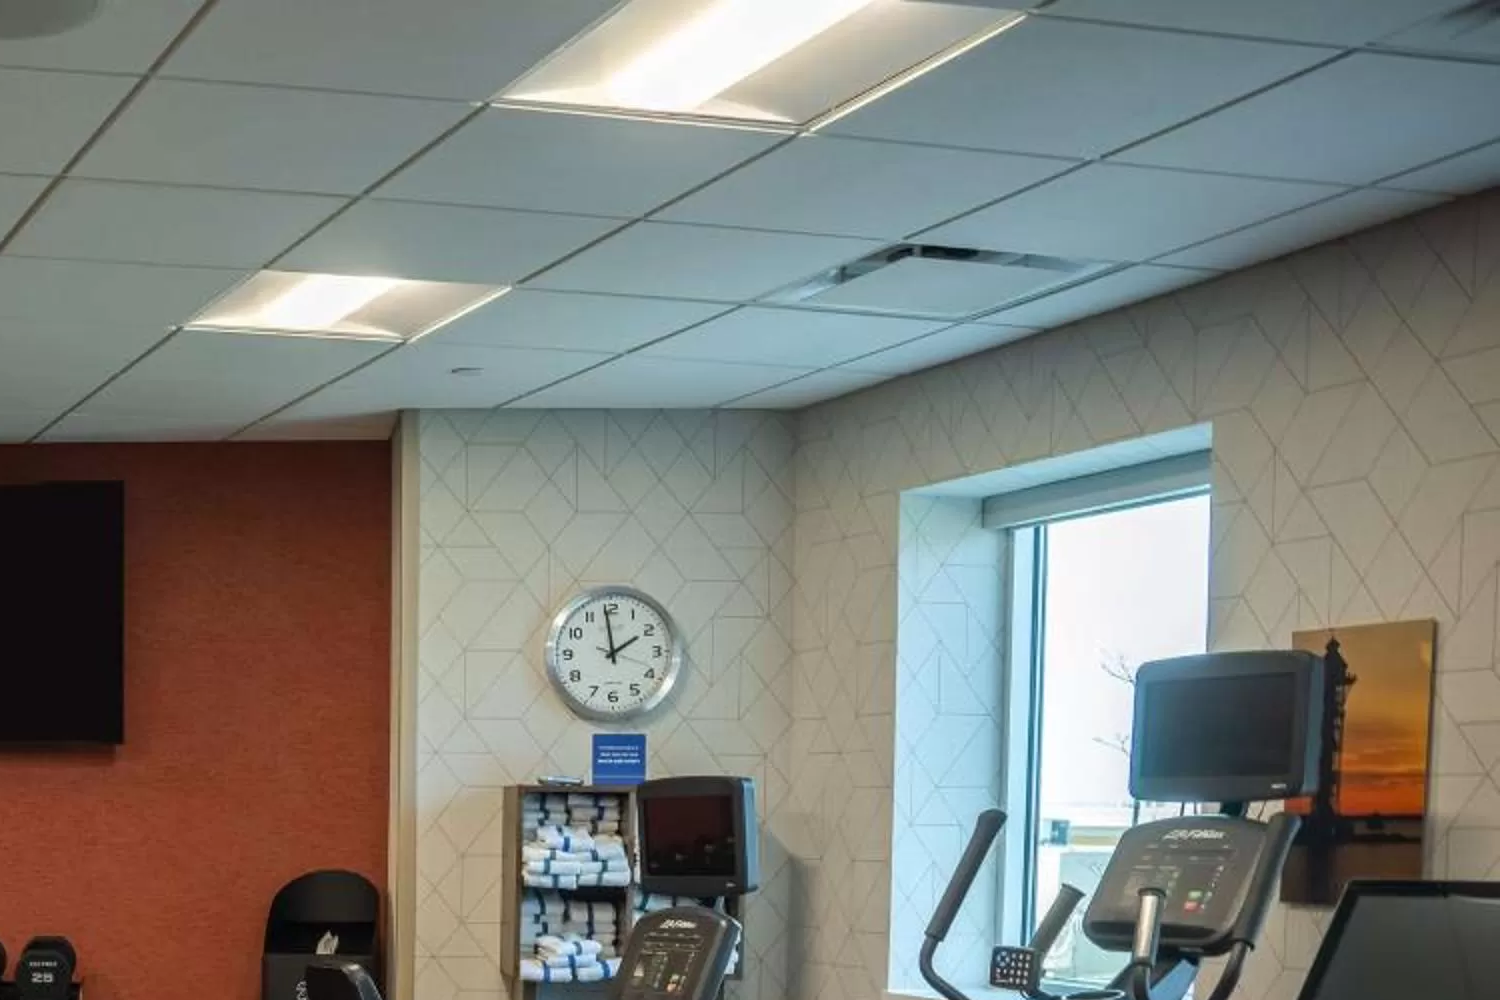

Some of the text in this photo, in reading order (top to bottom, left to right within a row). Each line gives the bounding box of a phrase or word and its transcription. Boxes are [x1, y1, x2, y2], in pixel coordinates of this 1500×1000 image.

[585, 611, 595, 623] 11
[569, 627, 583, 640] 10
[643, 623, 655, 637] 2
[563, 648, 573, 661] 9
[652, 645, 662, 658] 3
[569, 669, 581, 683] 8
[644, 668, 655, 679] 4
[588, 685, 600, 698] 7
[629, 683, 641, 696] 5
[607, 691, 619, 703] 6
[31, 971, 54, 983] 25
